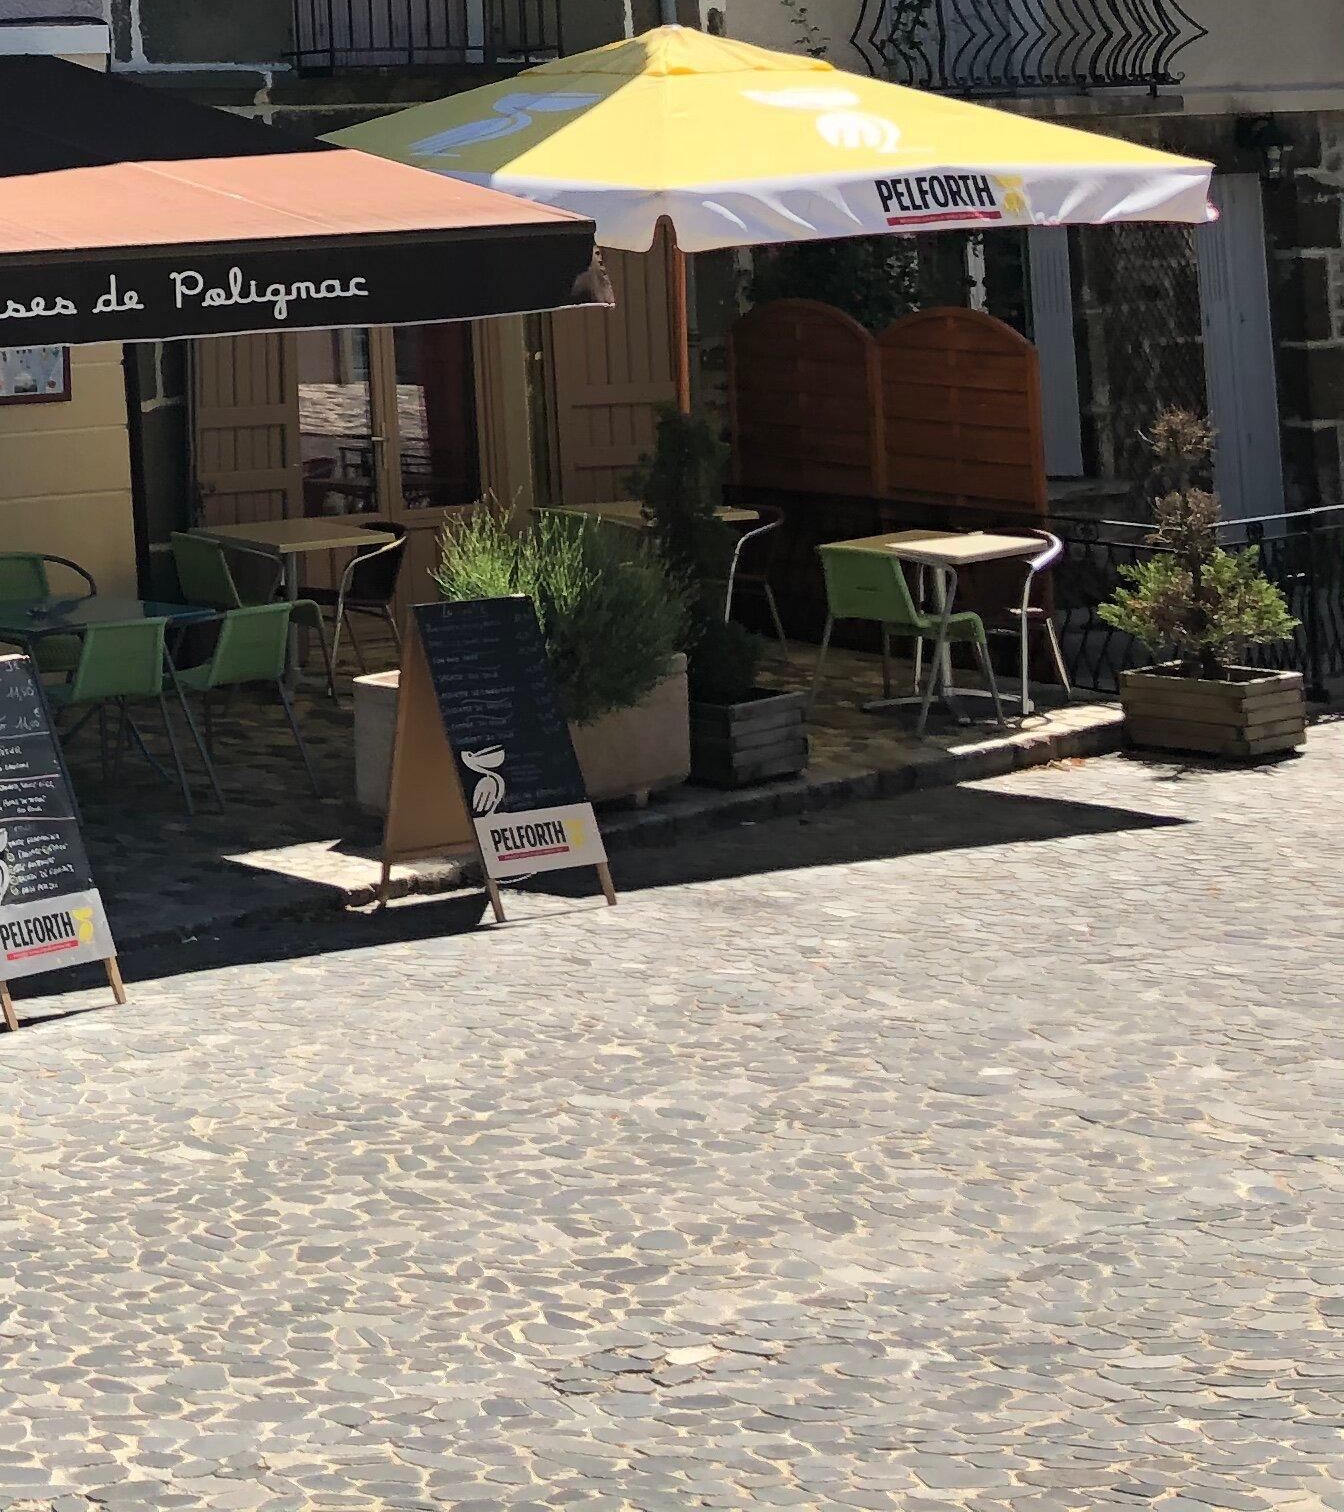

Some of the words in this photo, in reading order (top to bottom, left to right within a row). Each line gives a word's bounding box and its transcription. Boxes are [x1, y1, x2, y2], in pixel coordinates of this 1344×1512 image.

[875, 174, 997, 213] PELFORTH
[92, 274, 145, 315] de
[169, 266, 370, 321] Polignac
[490, 820, 567, 852] PELFORTH
